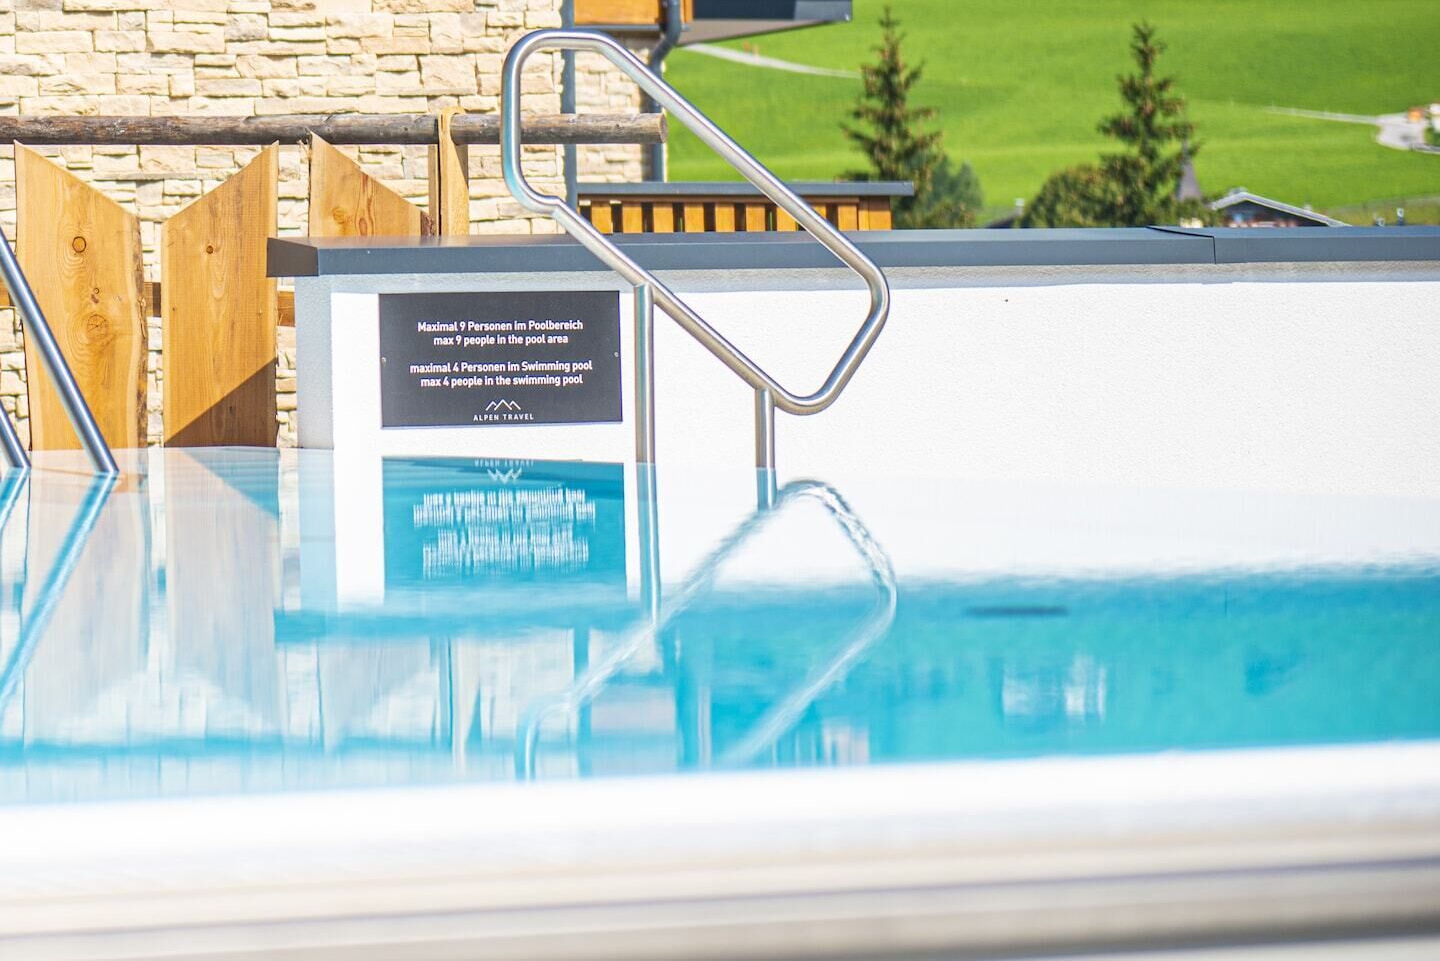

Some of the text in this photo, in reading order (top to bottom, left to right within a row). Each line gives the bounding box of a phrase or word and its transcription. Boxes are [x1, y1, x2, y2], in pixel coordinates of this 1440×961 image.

[417, 319, 584, 332] Maximal 9 Personen im Poolbereich
[433, 333, 569, 348] max 9 people in the pool area
[409, 359, 593, 374] maximal 4 Personen im Swimming pool
[420, 373, 584, 389] max 4 people in the swimming pool
[473, 413, 534, 422] ALPEN TRAVEL
